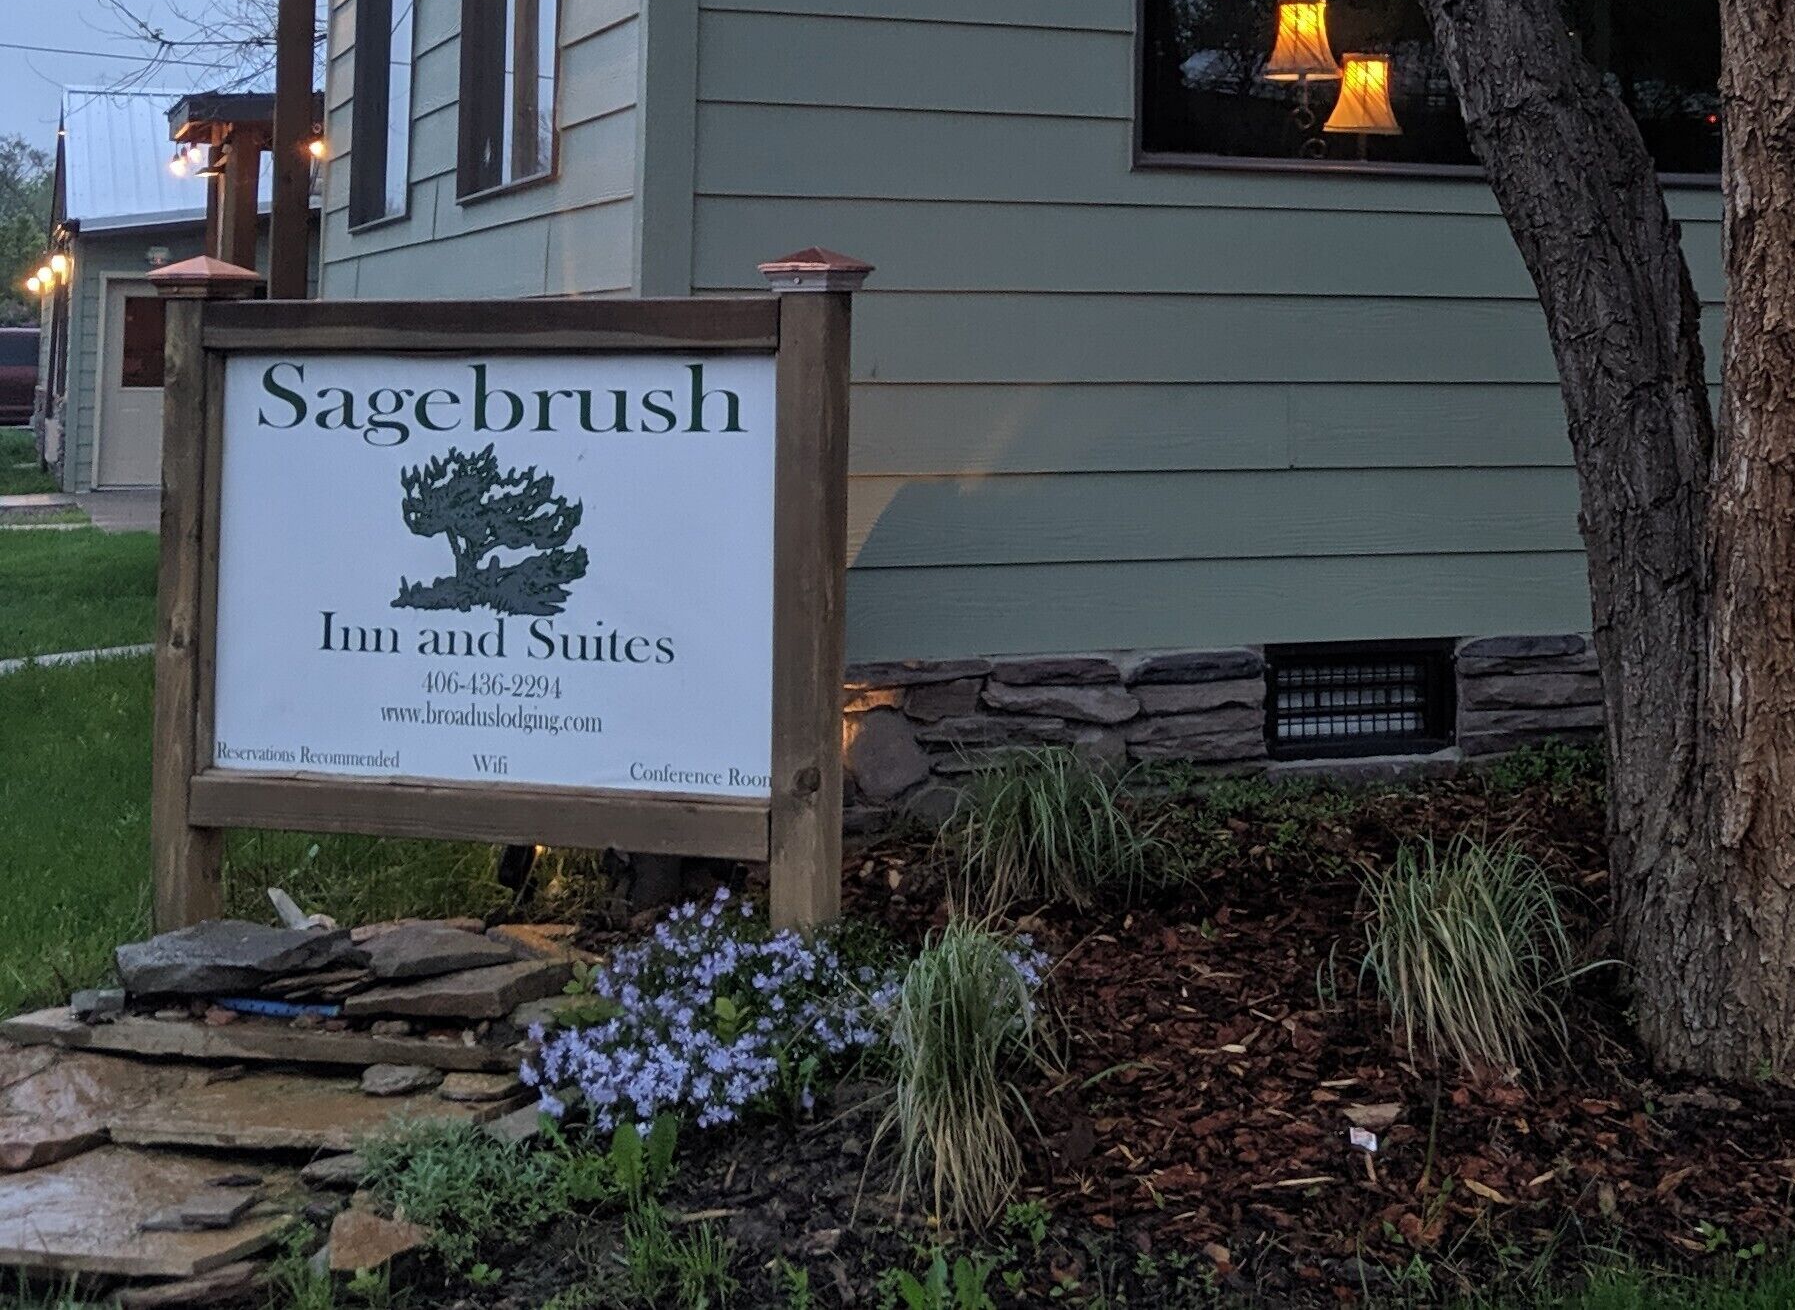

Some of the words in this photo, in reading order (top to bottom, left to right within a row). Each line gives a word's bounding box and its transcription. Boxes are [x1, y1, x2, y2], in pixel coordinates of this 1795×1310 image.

[257, 361, 749, 447] Sagebrush
[319, 610, 401, 655] Inn
[417, 616, 507, 659] and
[526, 619, 676, 665] Suites
[421, 670, 562, 699] 406-436-2294
[380, 701, 603, 736] www.broaduslodging.com
[216, 741, 296, 763] Reservations
[300, 746, 400, 769] Recommended
[472, 754, 509, 775] Wifi
[629, 761, 722, 786] Conference
